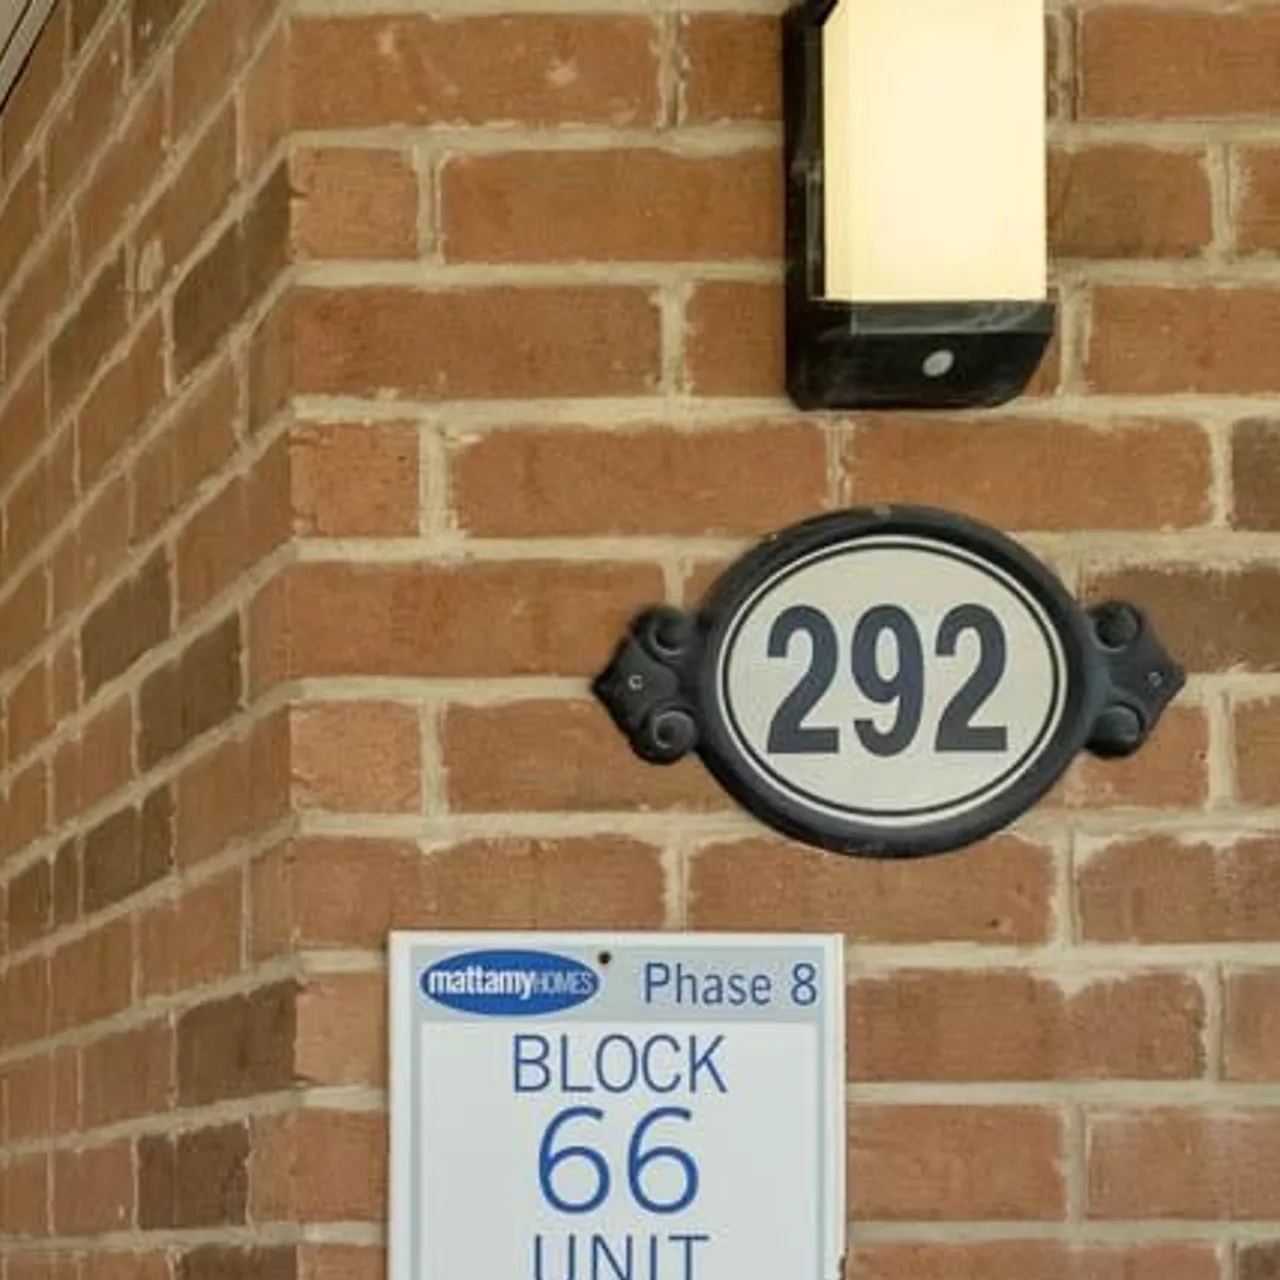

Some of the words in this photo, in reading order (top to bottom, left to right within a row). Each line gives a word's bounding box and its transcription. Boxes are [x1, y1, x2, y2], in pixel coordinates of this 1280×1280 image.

[766, 603, 1007, 757] 292
[644, 962, 772, 1006] Phase
[790, 962, 818, 1006] 8
[512, 1033, 728, 1095] BLOCK
[538, 1105, 699, 1214] 66
